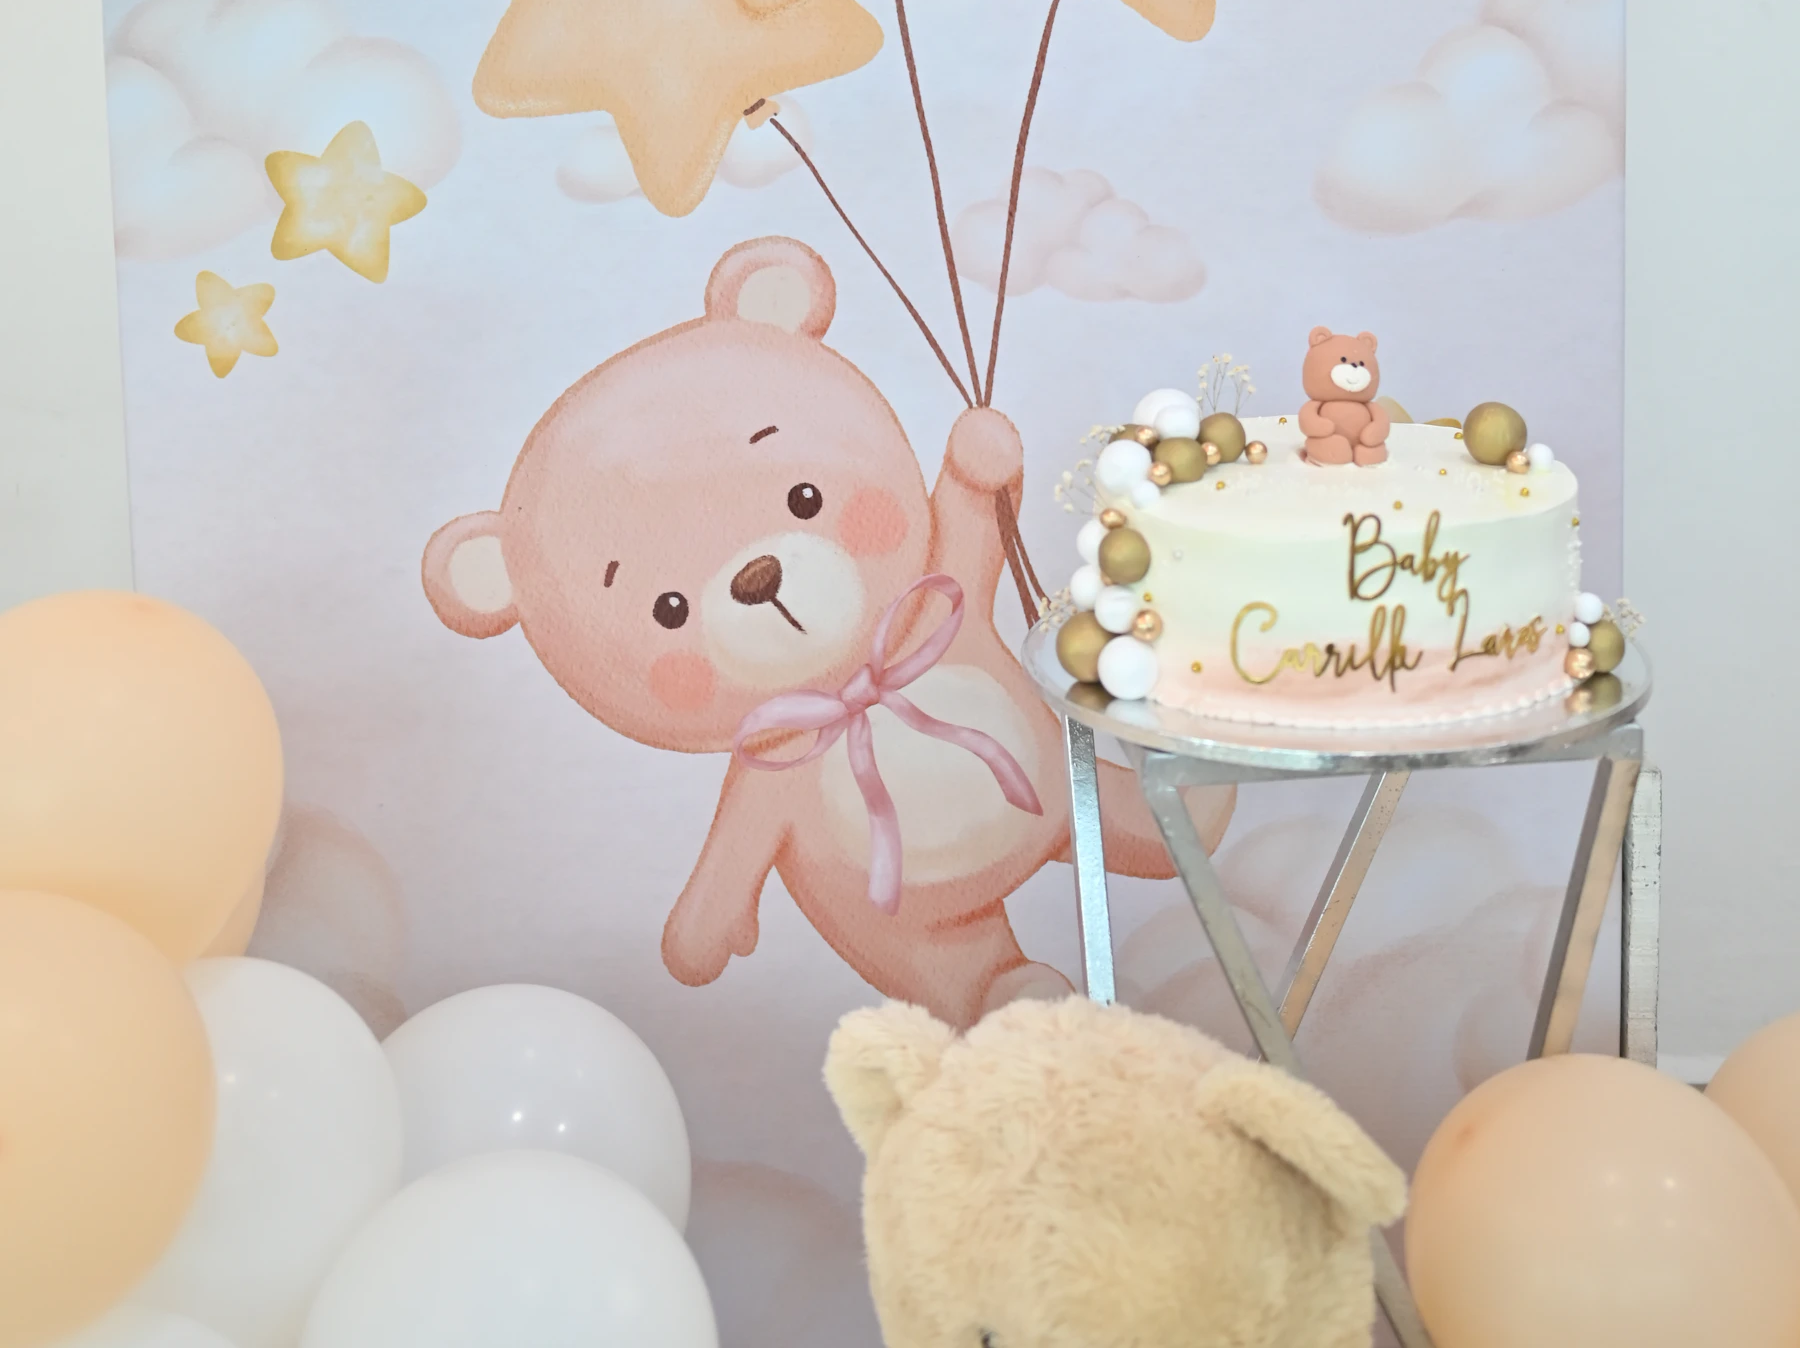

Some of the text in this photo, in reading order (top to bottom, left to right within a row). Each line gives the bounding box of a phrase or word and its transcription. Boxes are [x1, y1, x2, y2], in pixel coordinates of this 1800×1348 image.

[1342, 509, 1471, 617] Baby
[1230, 587, 1548, 693] Carrillo Lares
